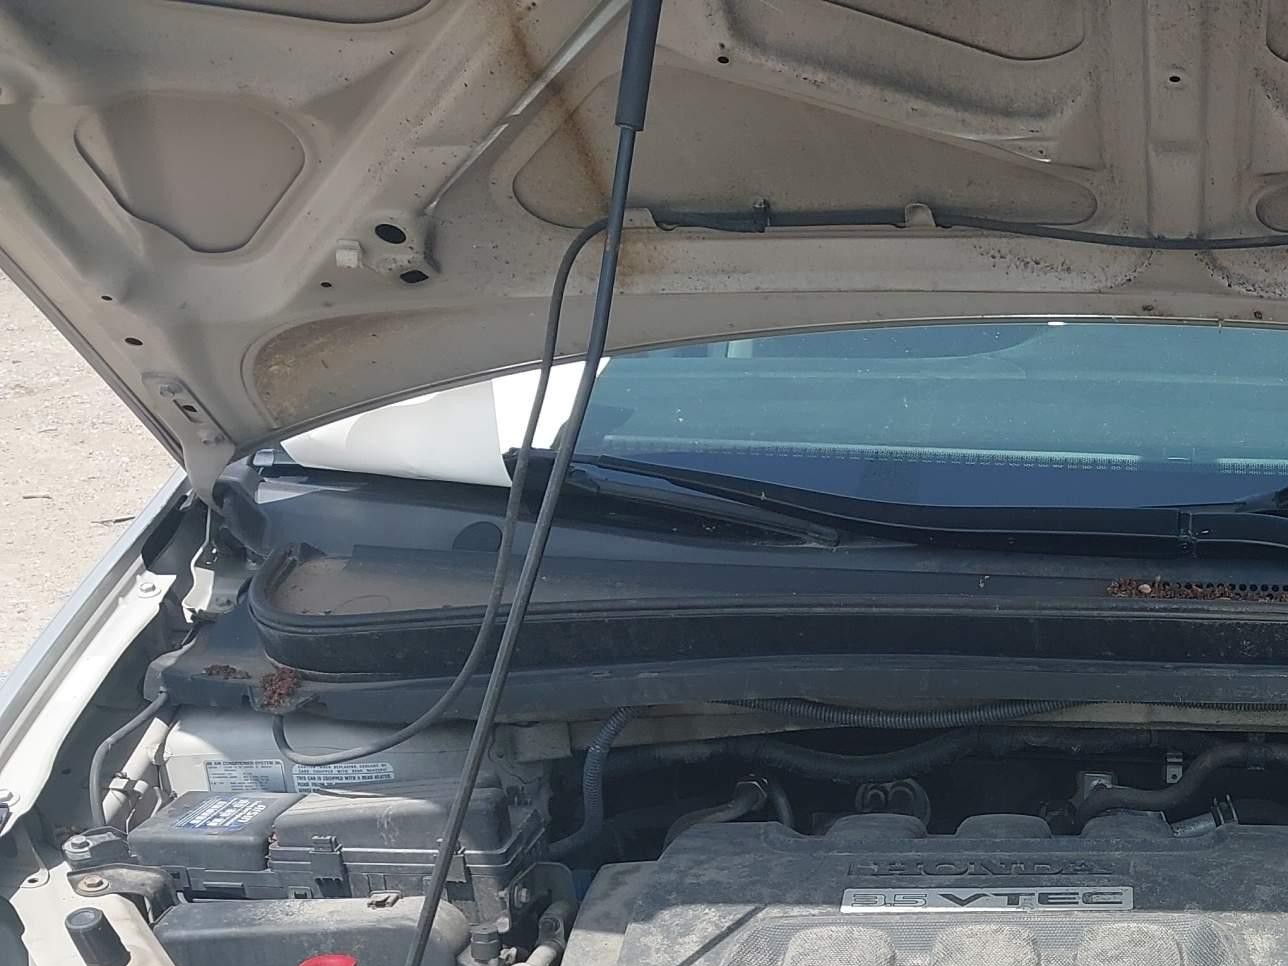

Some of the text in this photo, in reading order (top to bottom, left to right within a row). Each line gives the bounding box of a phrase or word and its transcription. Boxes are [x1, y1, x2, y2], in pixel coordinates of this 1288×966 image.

[870, 860, 1115, 877] HONDA
[851, 890, 1124, 908] 3.5 VTEC
